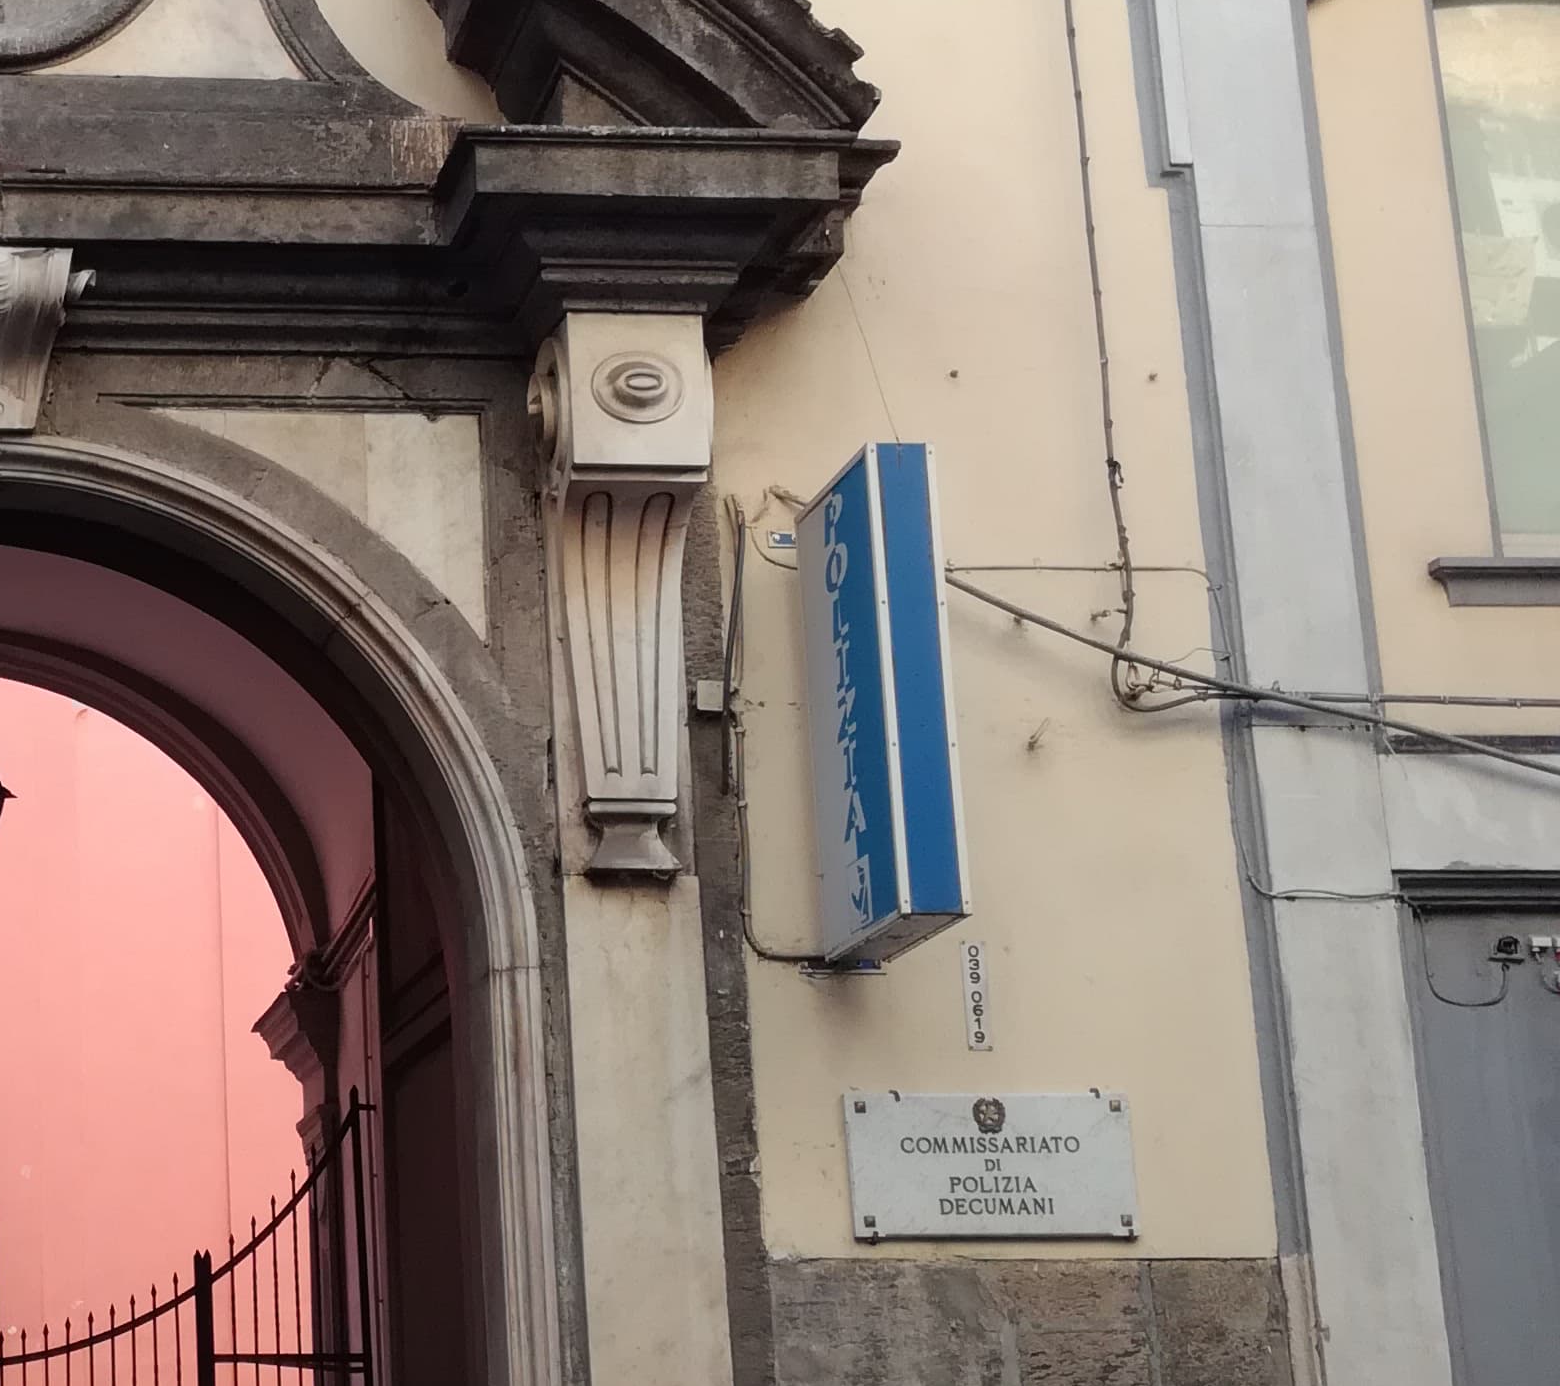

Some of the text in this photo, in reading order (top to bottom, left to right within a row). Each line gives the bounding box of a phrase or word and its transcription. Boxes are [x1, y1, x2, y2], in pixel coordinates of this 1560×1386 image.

[824, 491, 868, 844] POLIZIA
[899, 1136, 1081, 1155] COMMISSARIATO
[984, 1158, 1002, 1172] DI
[948, 1176, 1038, 1193] POLIZIA
[938, 1197, 1055, 1215] DECUMANI
